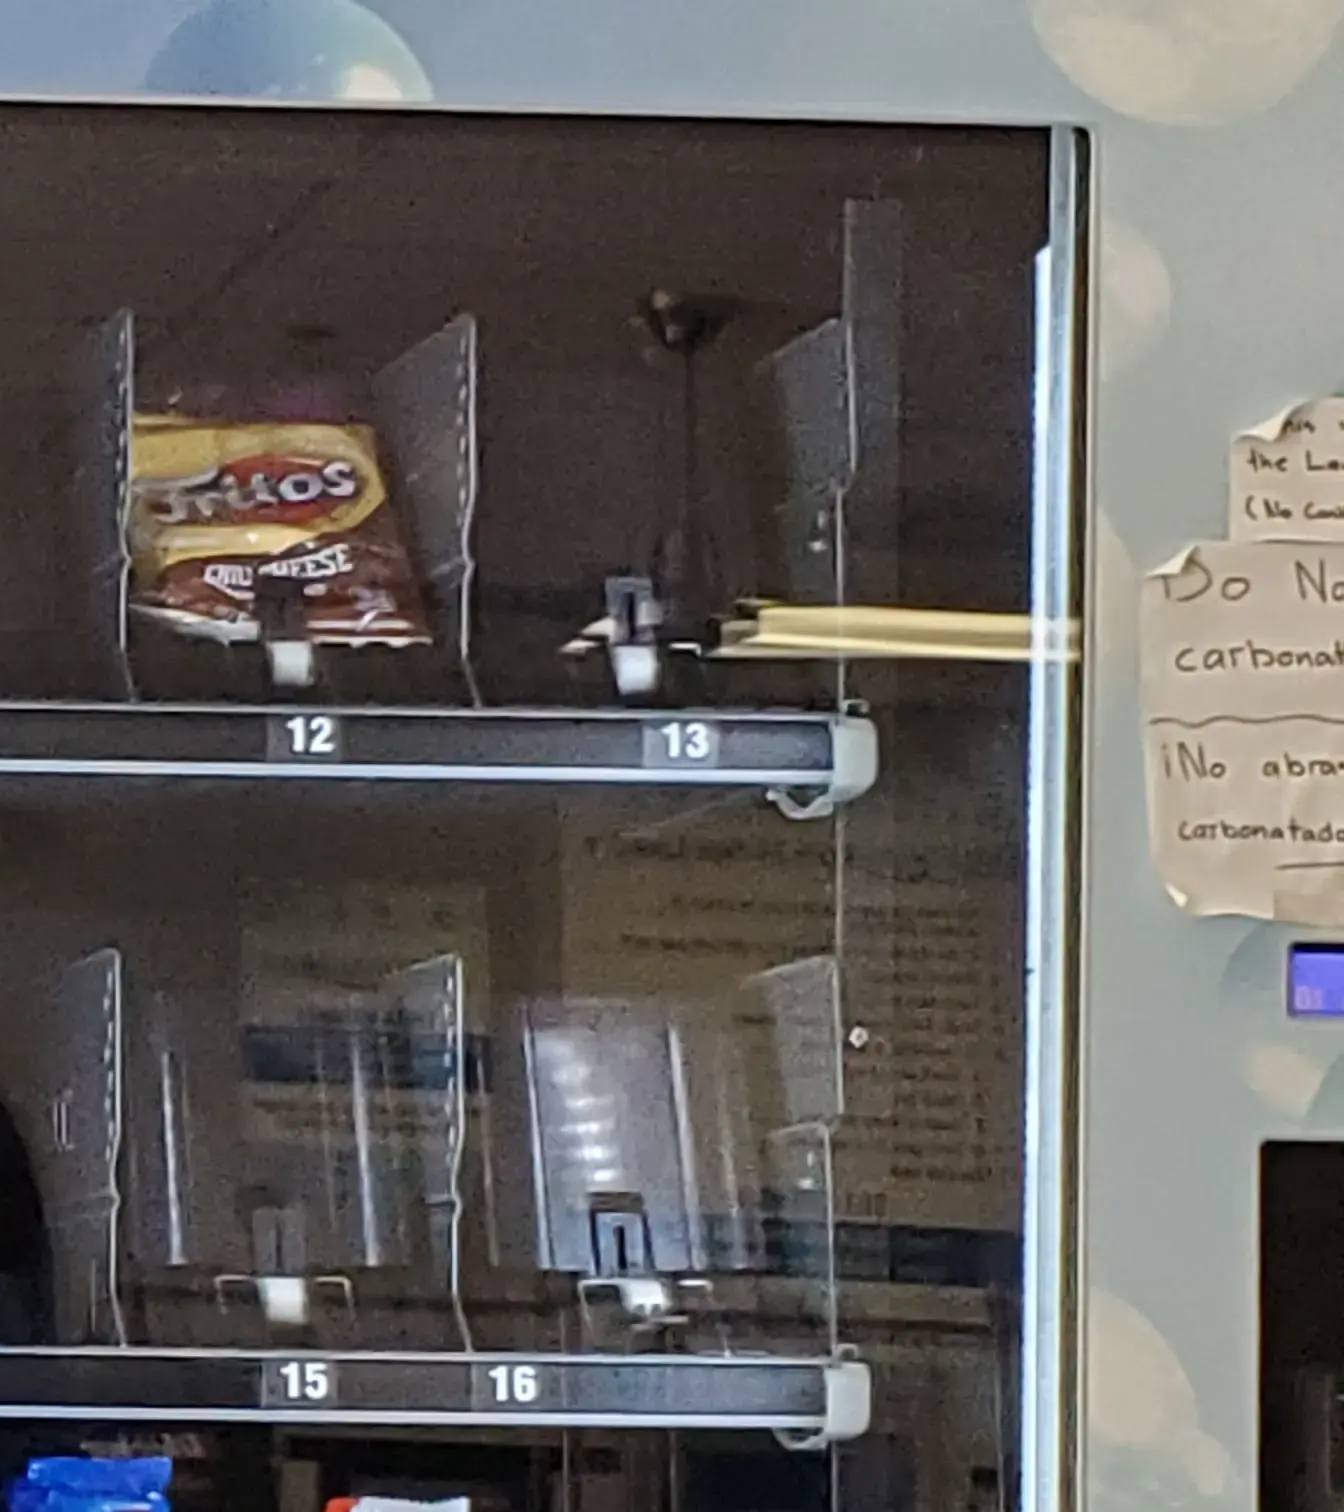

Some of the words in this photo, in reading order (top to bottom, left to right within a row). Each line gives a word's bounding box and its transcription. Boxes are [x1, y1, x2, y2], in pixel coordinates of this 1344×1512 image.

[1246, 447, 1288, 474] the
[1161, 556, 1251, 602] Do
[286, 716, 333, 754] 12
[661, 722, 710, 760] 13
[279, 1361, 329, 1399] 15
[488, 1364, 538, 1402] 16
